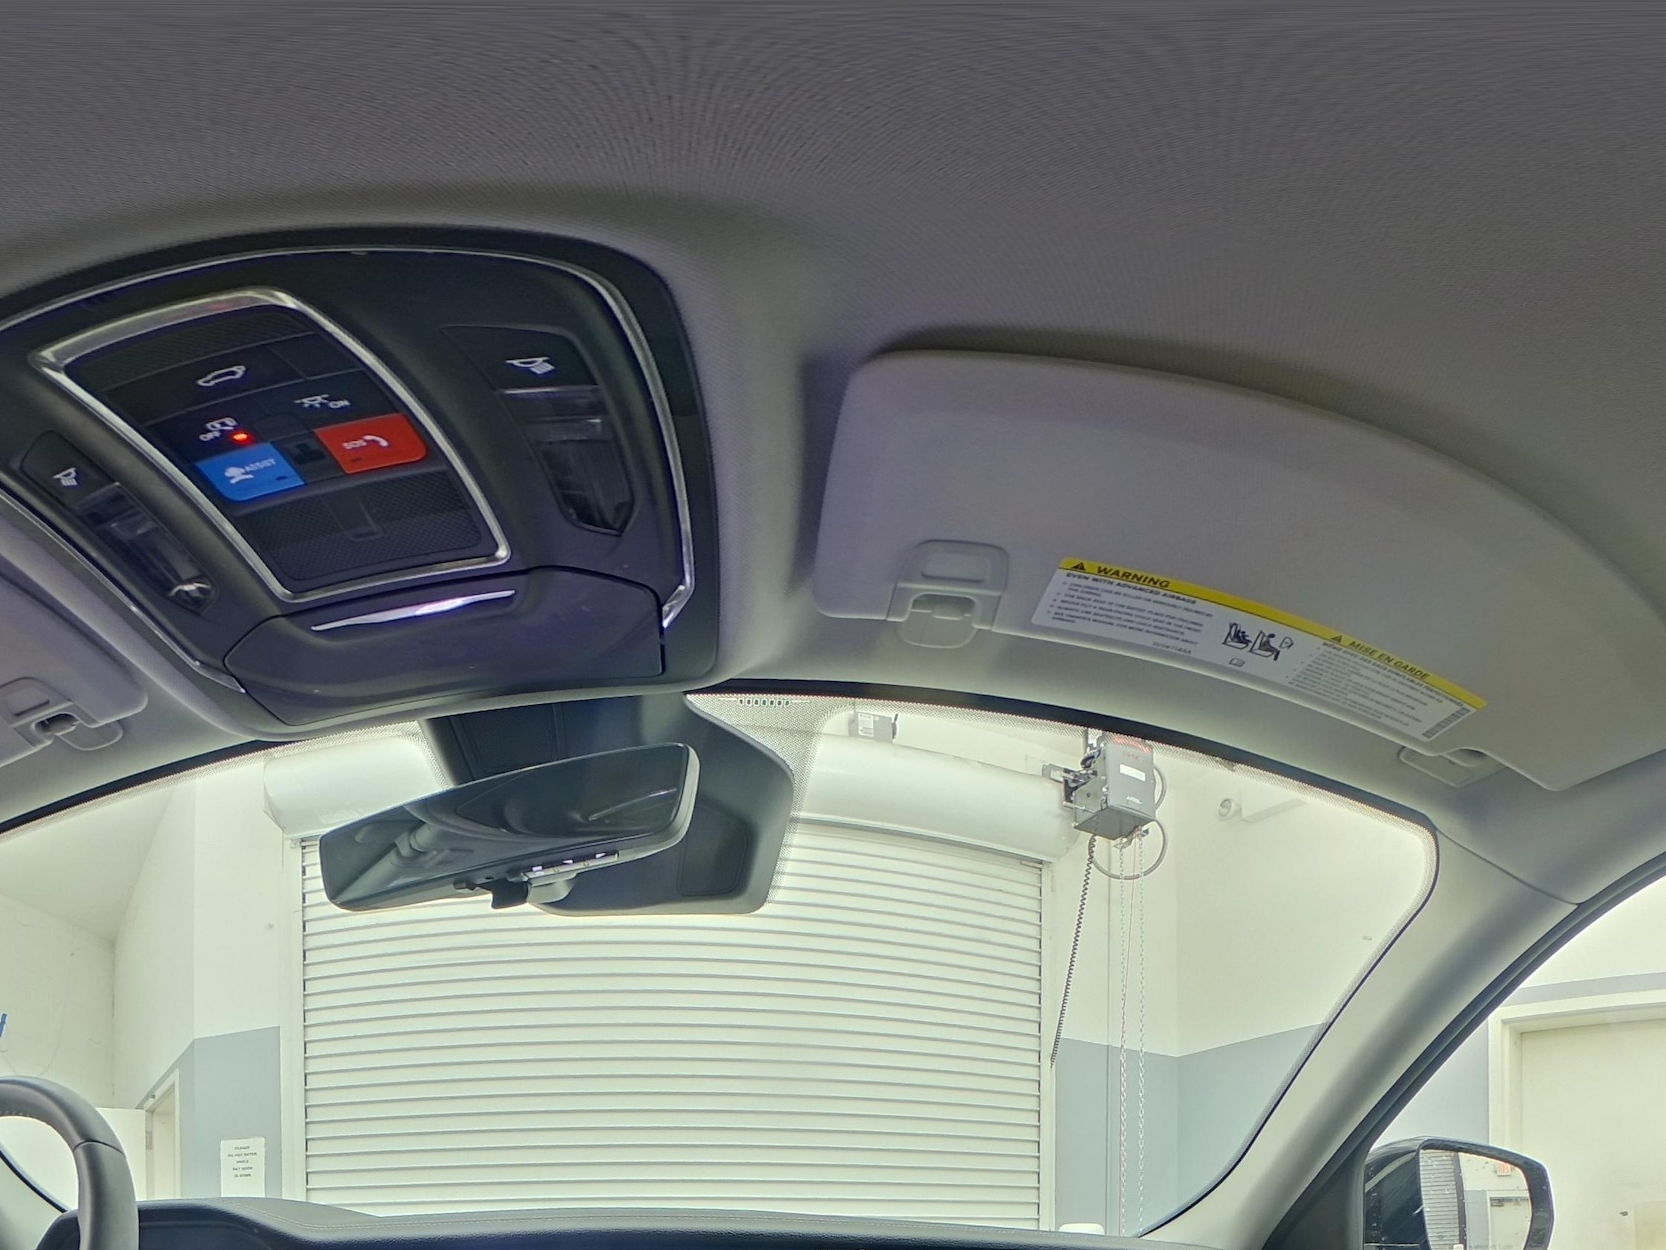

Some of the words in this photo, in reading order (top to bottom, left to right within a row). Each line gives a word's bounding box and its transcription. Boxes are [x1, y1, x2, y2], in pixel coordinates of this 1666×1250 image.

[328, 399, 351, 409] ON
[199, 430, 221, 442] OFF
[342, 438, 367, 450] SOS
[245, 458, 277, 473] ASSIST
[1066, 572, 1090, 580] EVEN
[1116, 582, 1160, 595] ADVANCED
[1096, 565, 1171, 588] WARNING
[1348, 641, 1378, 656] MISE
[1377, 653, 1395, 664] EN
[1393, 660, 1430, 680] GARDE
